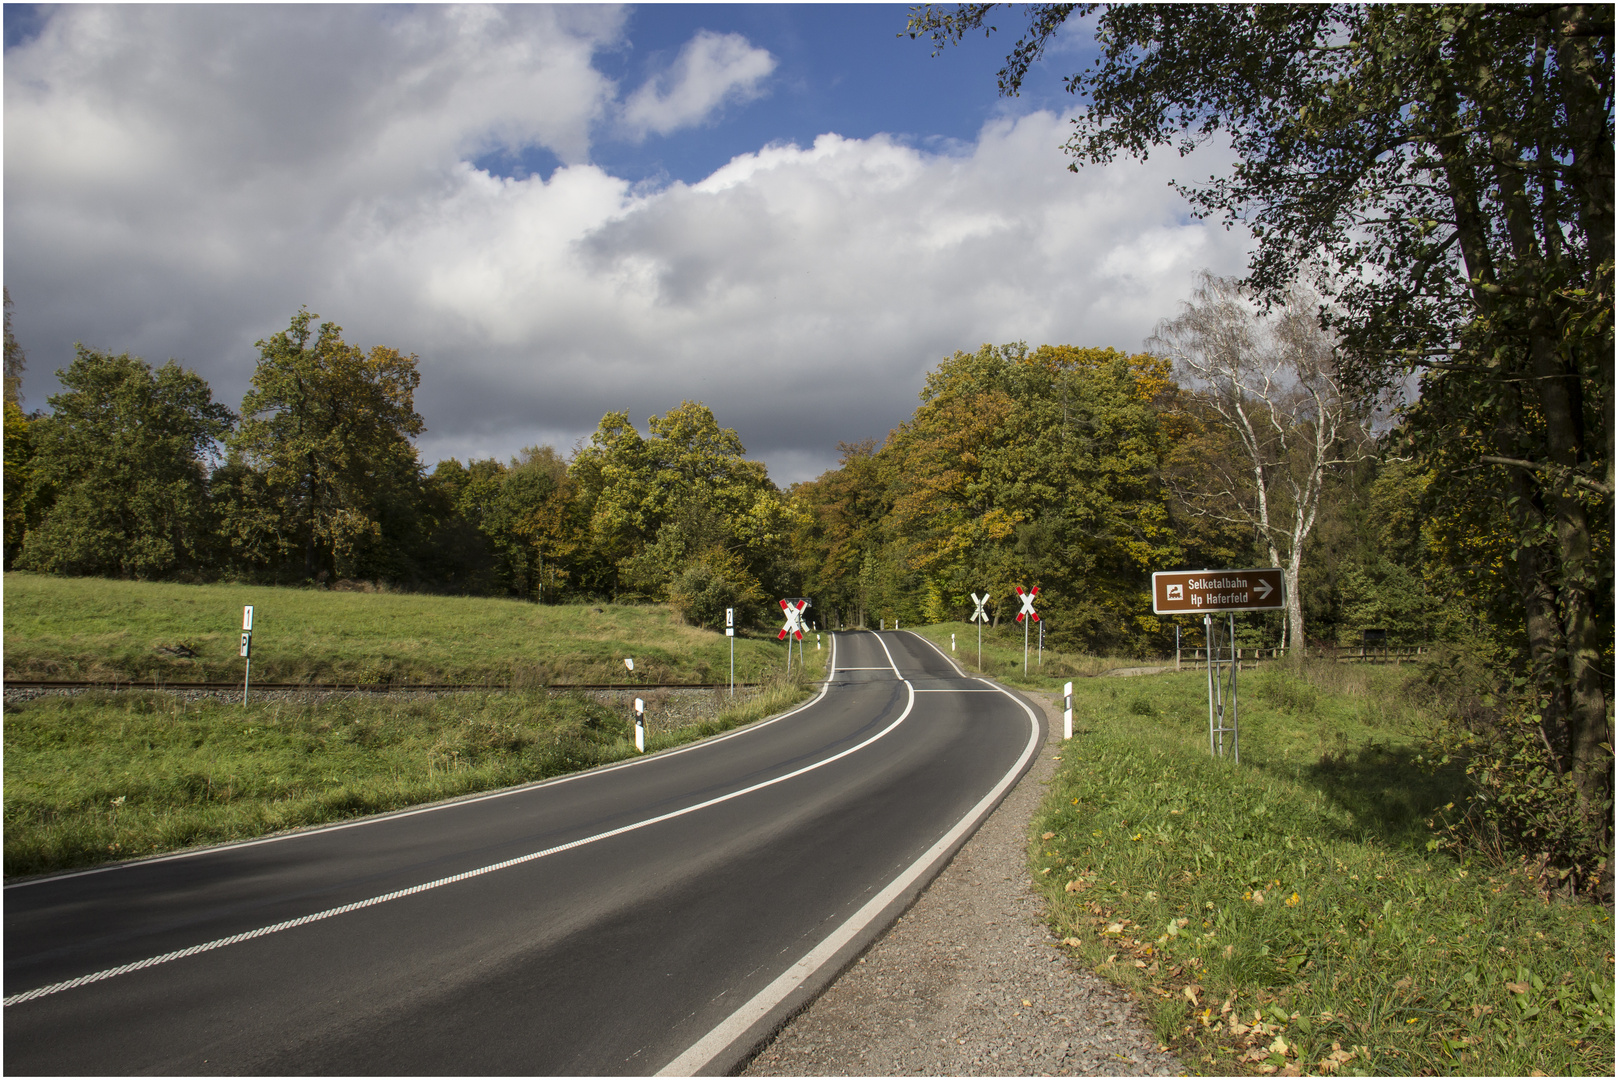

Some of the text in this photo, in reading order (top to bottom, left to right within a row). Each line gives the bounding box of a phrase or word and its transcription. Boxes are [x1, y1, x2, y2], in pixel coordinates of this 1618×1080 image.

[1188, 577, 1248, 590] Selketalbahn
[1191, 592, 1249, 607] Hp Haferfeld
[241, 636, 248, 654] P
